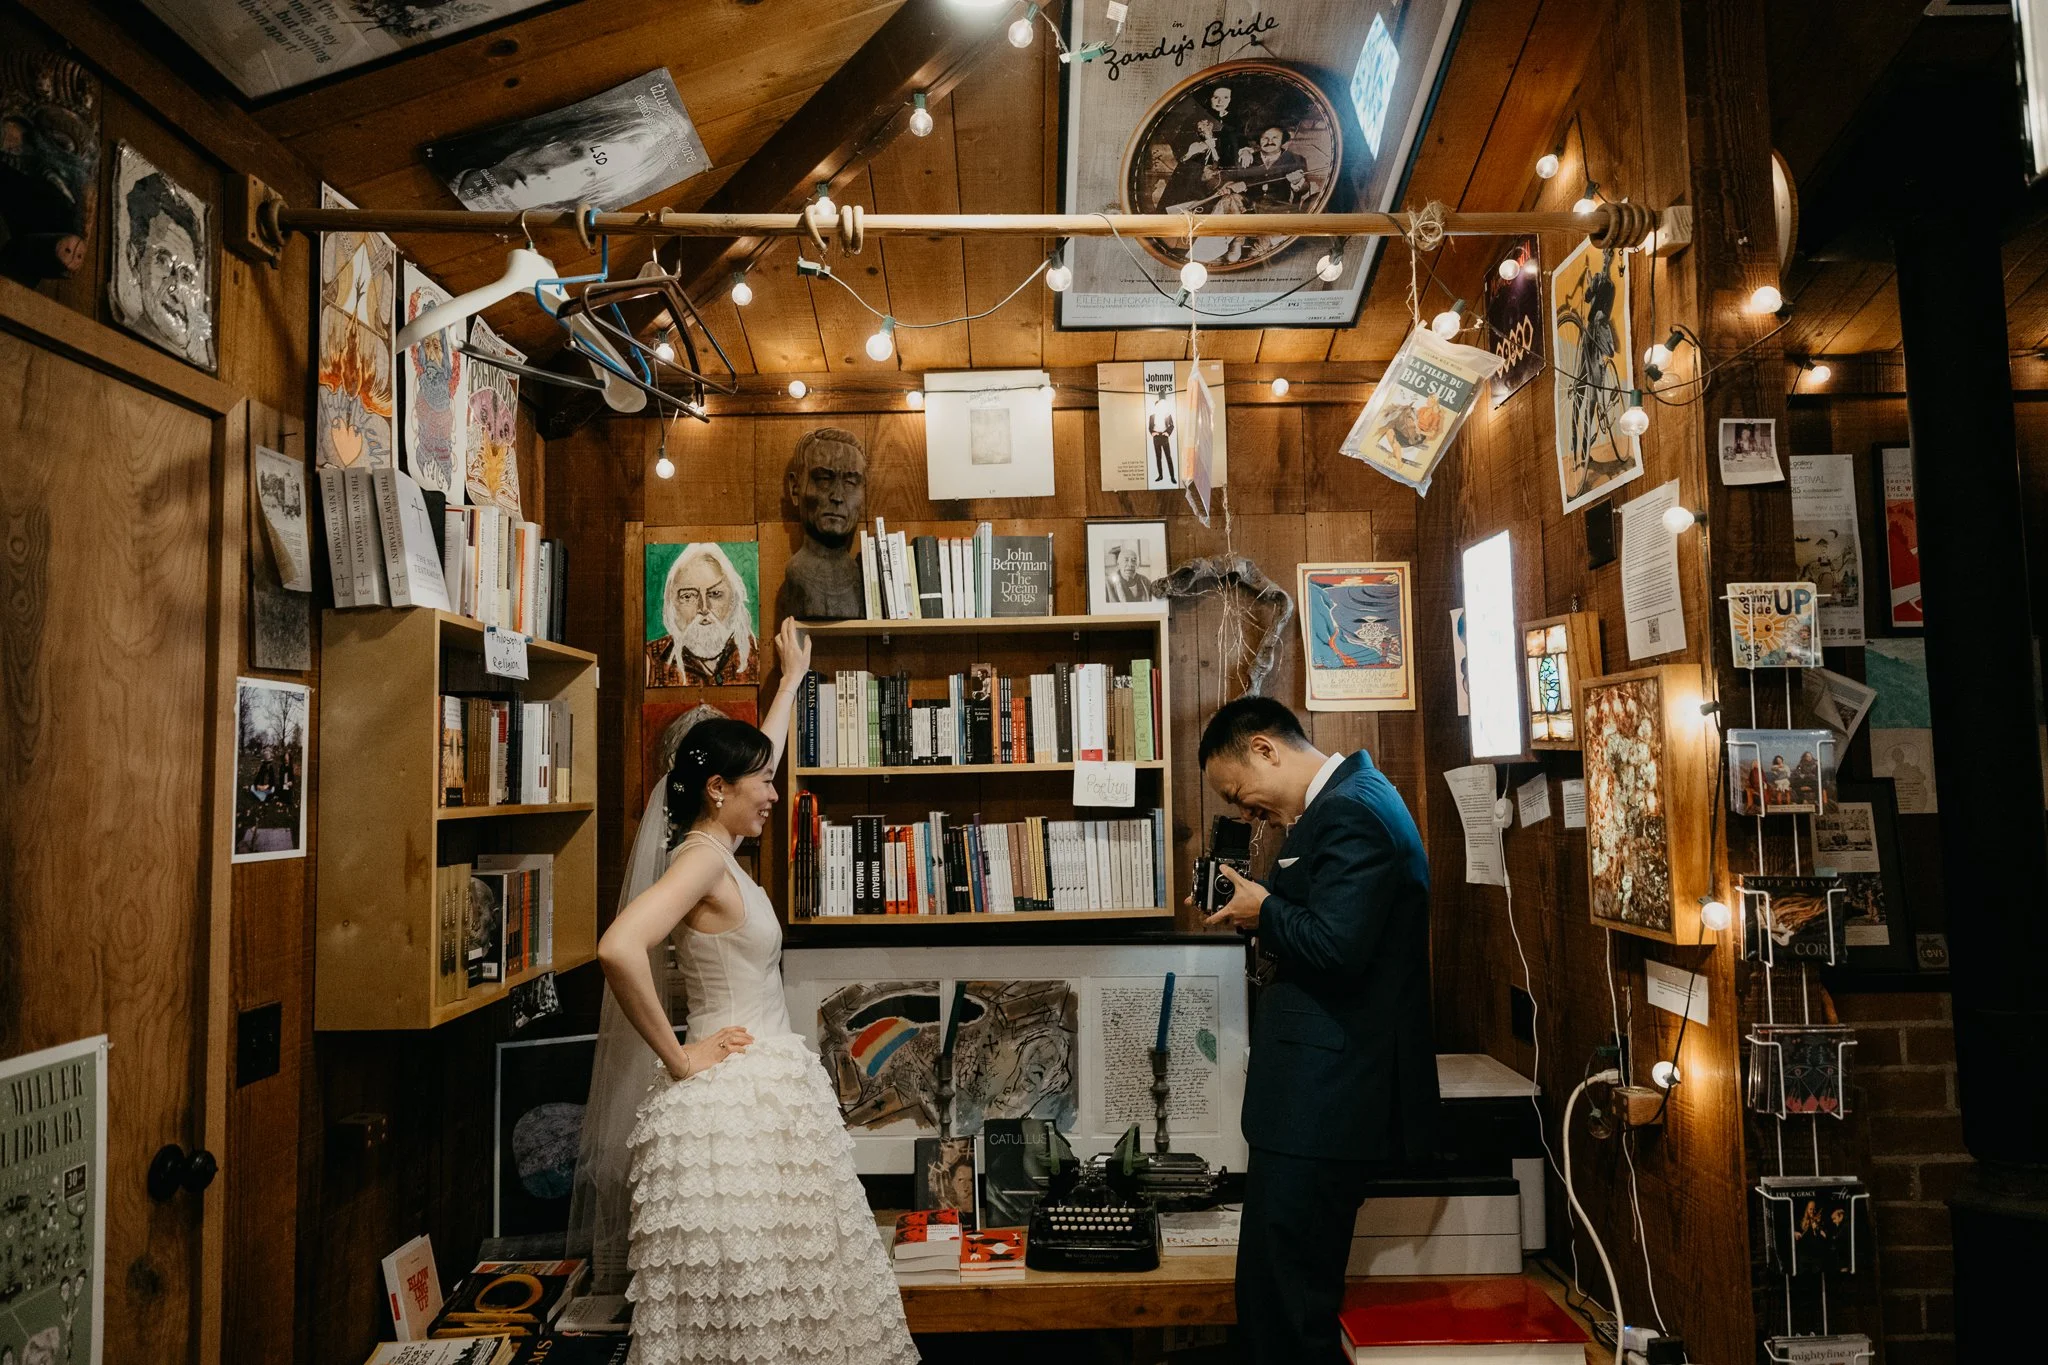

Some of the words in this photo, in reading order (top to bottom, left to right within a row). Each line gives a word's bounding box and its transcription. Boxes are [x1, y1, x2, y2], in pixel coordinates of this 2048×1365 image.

[1171, 19, 1186, 29] in
[292, 26, 332, 64] nothing
[314, 24, 342, 47] they
[1103, 34, 1196, 82] Zandy's
[1200, 11, 1280, 49] Bride
[588, 144, 609, 167] LSD
[1145, 373, 1174, 382] Johnny
[1408, 357, 1422, 371] LA
[1420, 362, 1449, 382] FILLE
[1448, 376, 1464, 390] DU
[1148, 383, 1173, 393] Rivers
[1400, 367, 1427, 390] BIG
[1426, 380, 1459, 405] SUR
[326, 475, 335, 496] THE
[350, 474, 359, 493] THE
[380, 475, 389, 496] THE
[329, 497, 338, 515] NEW
[352, 493, 360, 511] NEW
[383, 497, 392, 516] NEW
[331, 516, 344, 566] TESTAMENT
[354, 512, 365, 564] TESTAMENT
[386, 516, 400, 565] TESTAMENT
[1005, 547, 1033, 561] John
[992, 558, 1047, 575] Berryman
[1000, 581, 1038, 594] Dream
[1007, 571, 1032, 585] The
[337, 589, 351, 598] Yale
[357, 588, 371, 596] Yale
[394, 589, 407, 597] Yale
[1002, 591, 1036, 606] Songs
[1742, 603, 1771, 615] Side
[1774, 588, 1811, 616] UP
[491, 631, 522, 653] Philosophy
[492, 657, 521, 672] Religion
[808, 675, 816, 708] POEMS
[1086, 773, 1130, 795] Poetry
[855, 860, 865, 899] RIMBAUD
[871, 860, 881, 899] RIMBAUD
[1794, 943, 1840, 956] COR
[10, 1063, 83, 1117] MILLER
[0, 1107, 85, 1169] LIBRARY
[989, 1132, 1048, 1146] CATULLUS
[406, 1265, 430, 1292] BLOW
[414, 1284, 430, 1302] ING
[416, 1298, 430, 1313] UP
